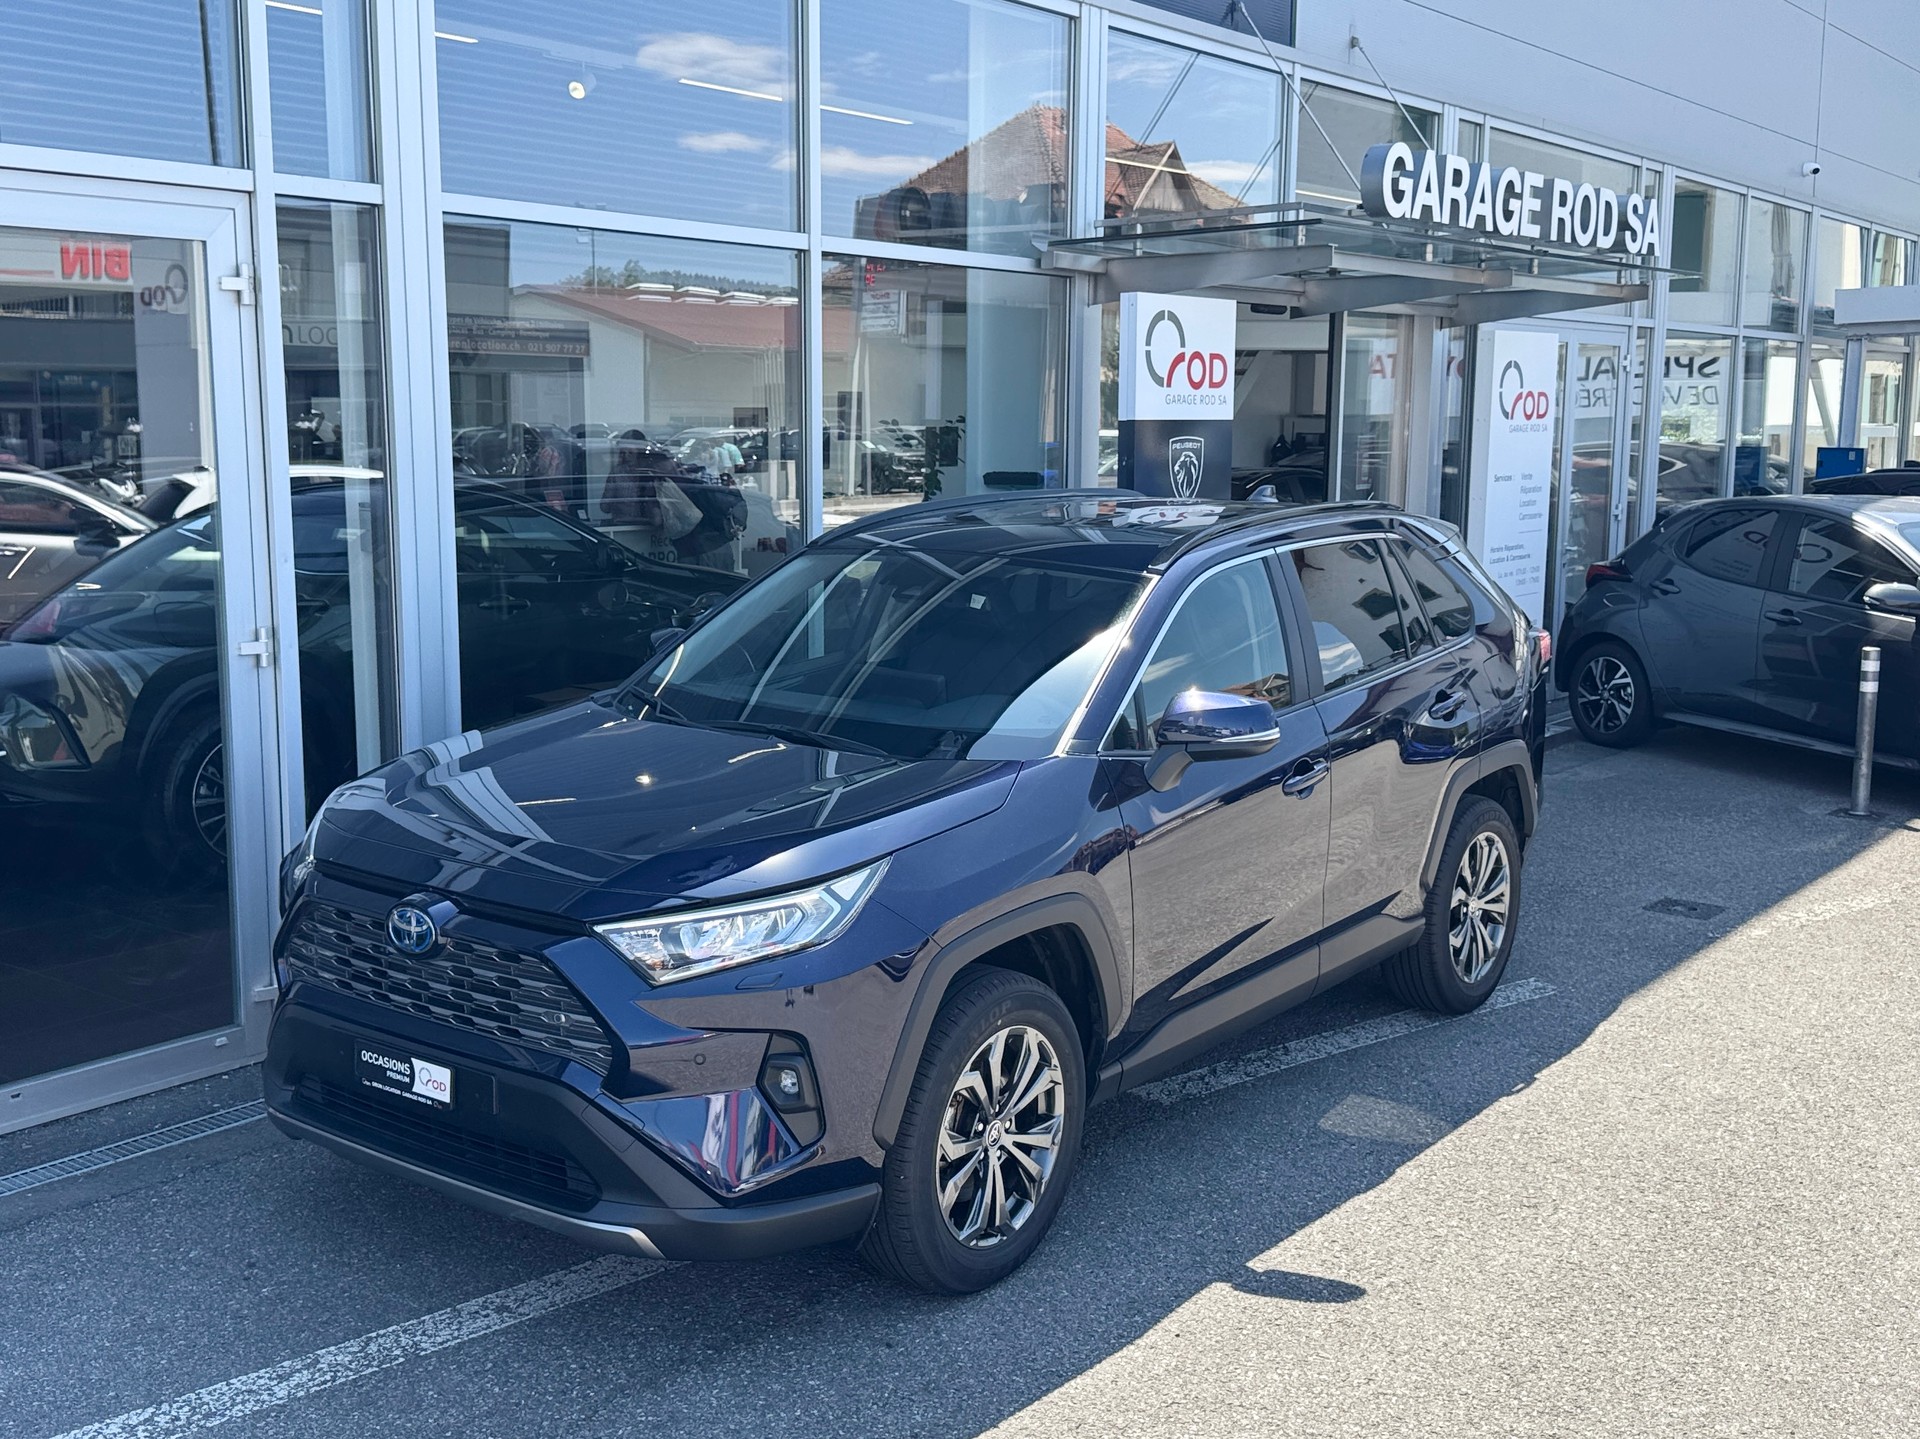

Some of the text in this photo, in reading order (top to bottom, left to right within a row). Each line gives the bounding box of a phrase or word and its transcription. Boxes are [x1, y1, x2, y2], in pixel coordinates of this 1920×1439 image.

[1383, 142, 1660, 257] GARAGE ROD SA
[1165, 394, 1227, 405] GARAGE ROD SA
[1509, 424, 1548, 433] GARAGE ROD SA
[1172, 442, 1201, 450] PEUGEOT
[1494, 474, 1512, 482] Services
[361, 1050, 411, 1075] OCCASIONS
[386, 1070, 410, 1083] PREMIUM
